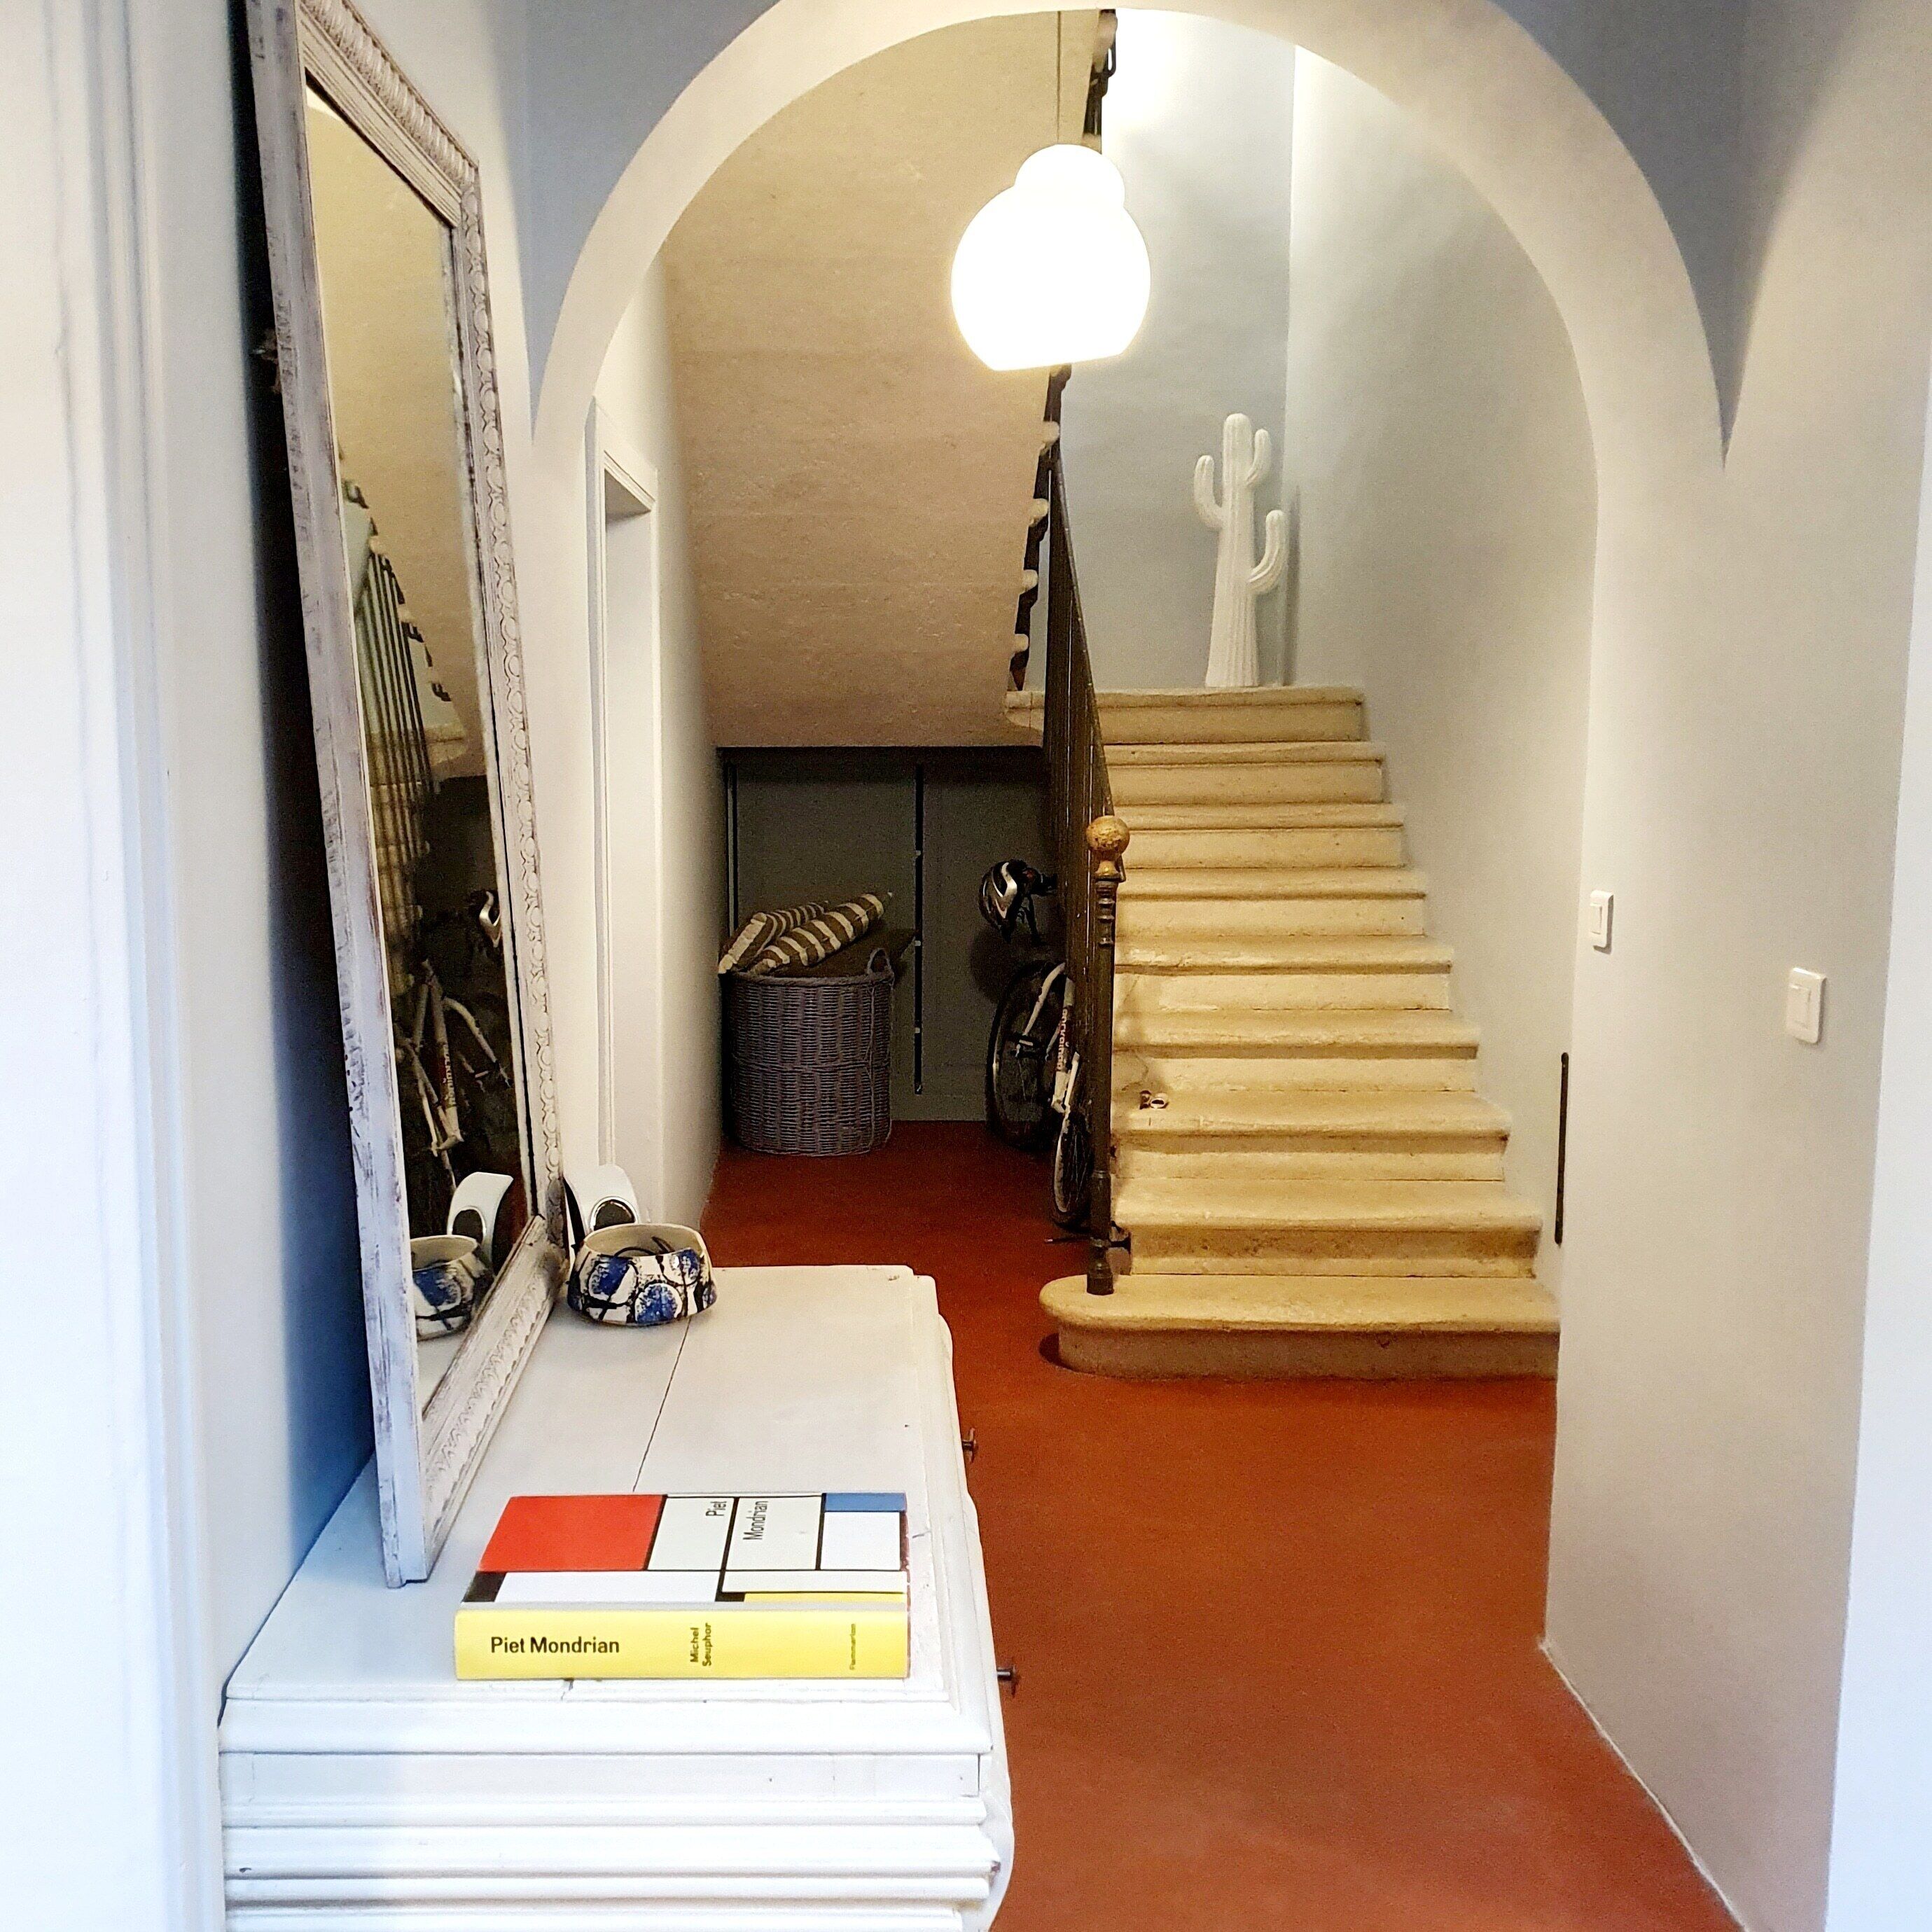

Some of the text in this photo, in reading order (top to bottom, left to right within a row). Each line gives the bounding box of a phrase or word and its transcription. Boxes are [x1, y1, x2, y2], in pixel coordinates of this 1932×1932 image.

[704, 1501, 728, 1516] Piet
[742, 1501, 769, 1541] Mondrian
[490, 1635, 620, 1653] Piet Mondrian
[690, 1627, 700, 1663] Michel
[702, 1622, 713, 1666] Seuphor
